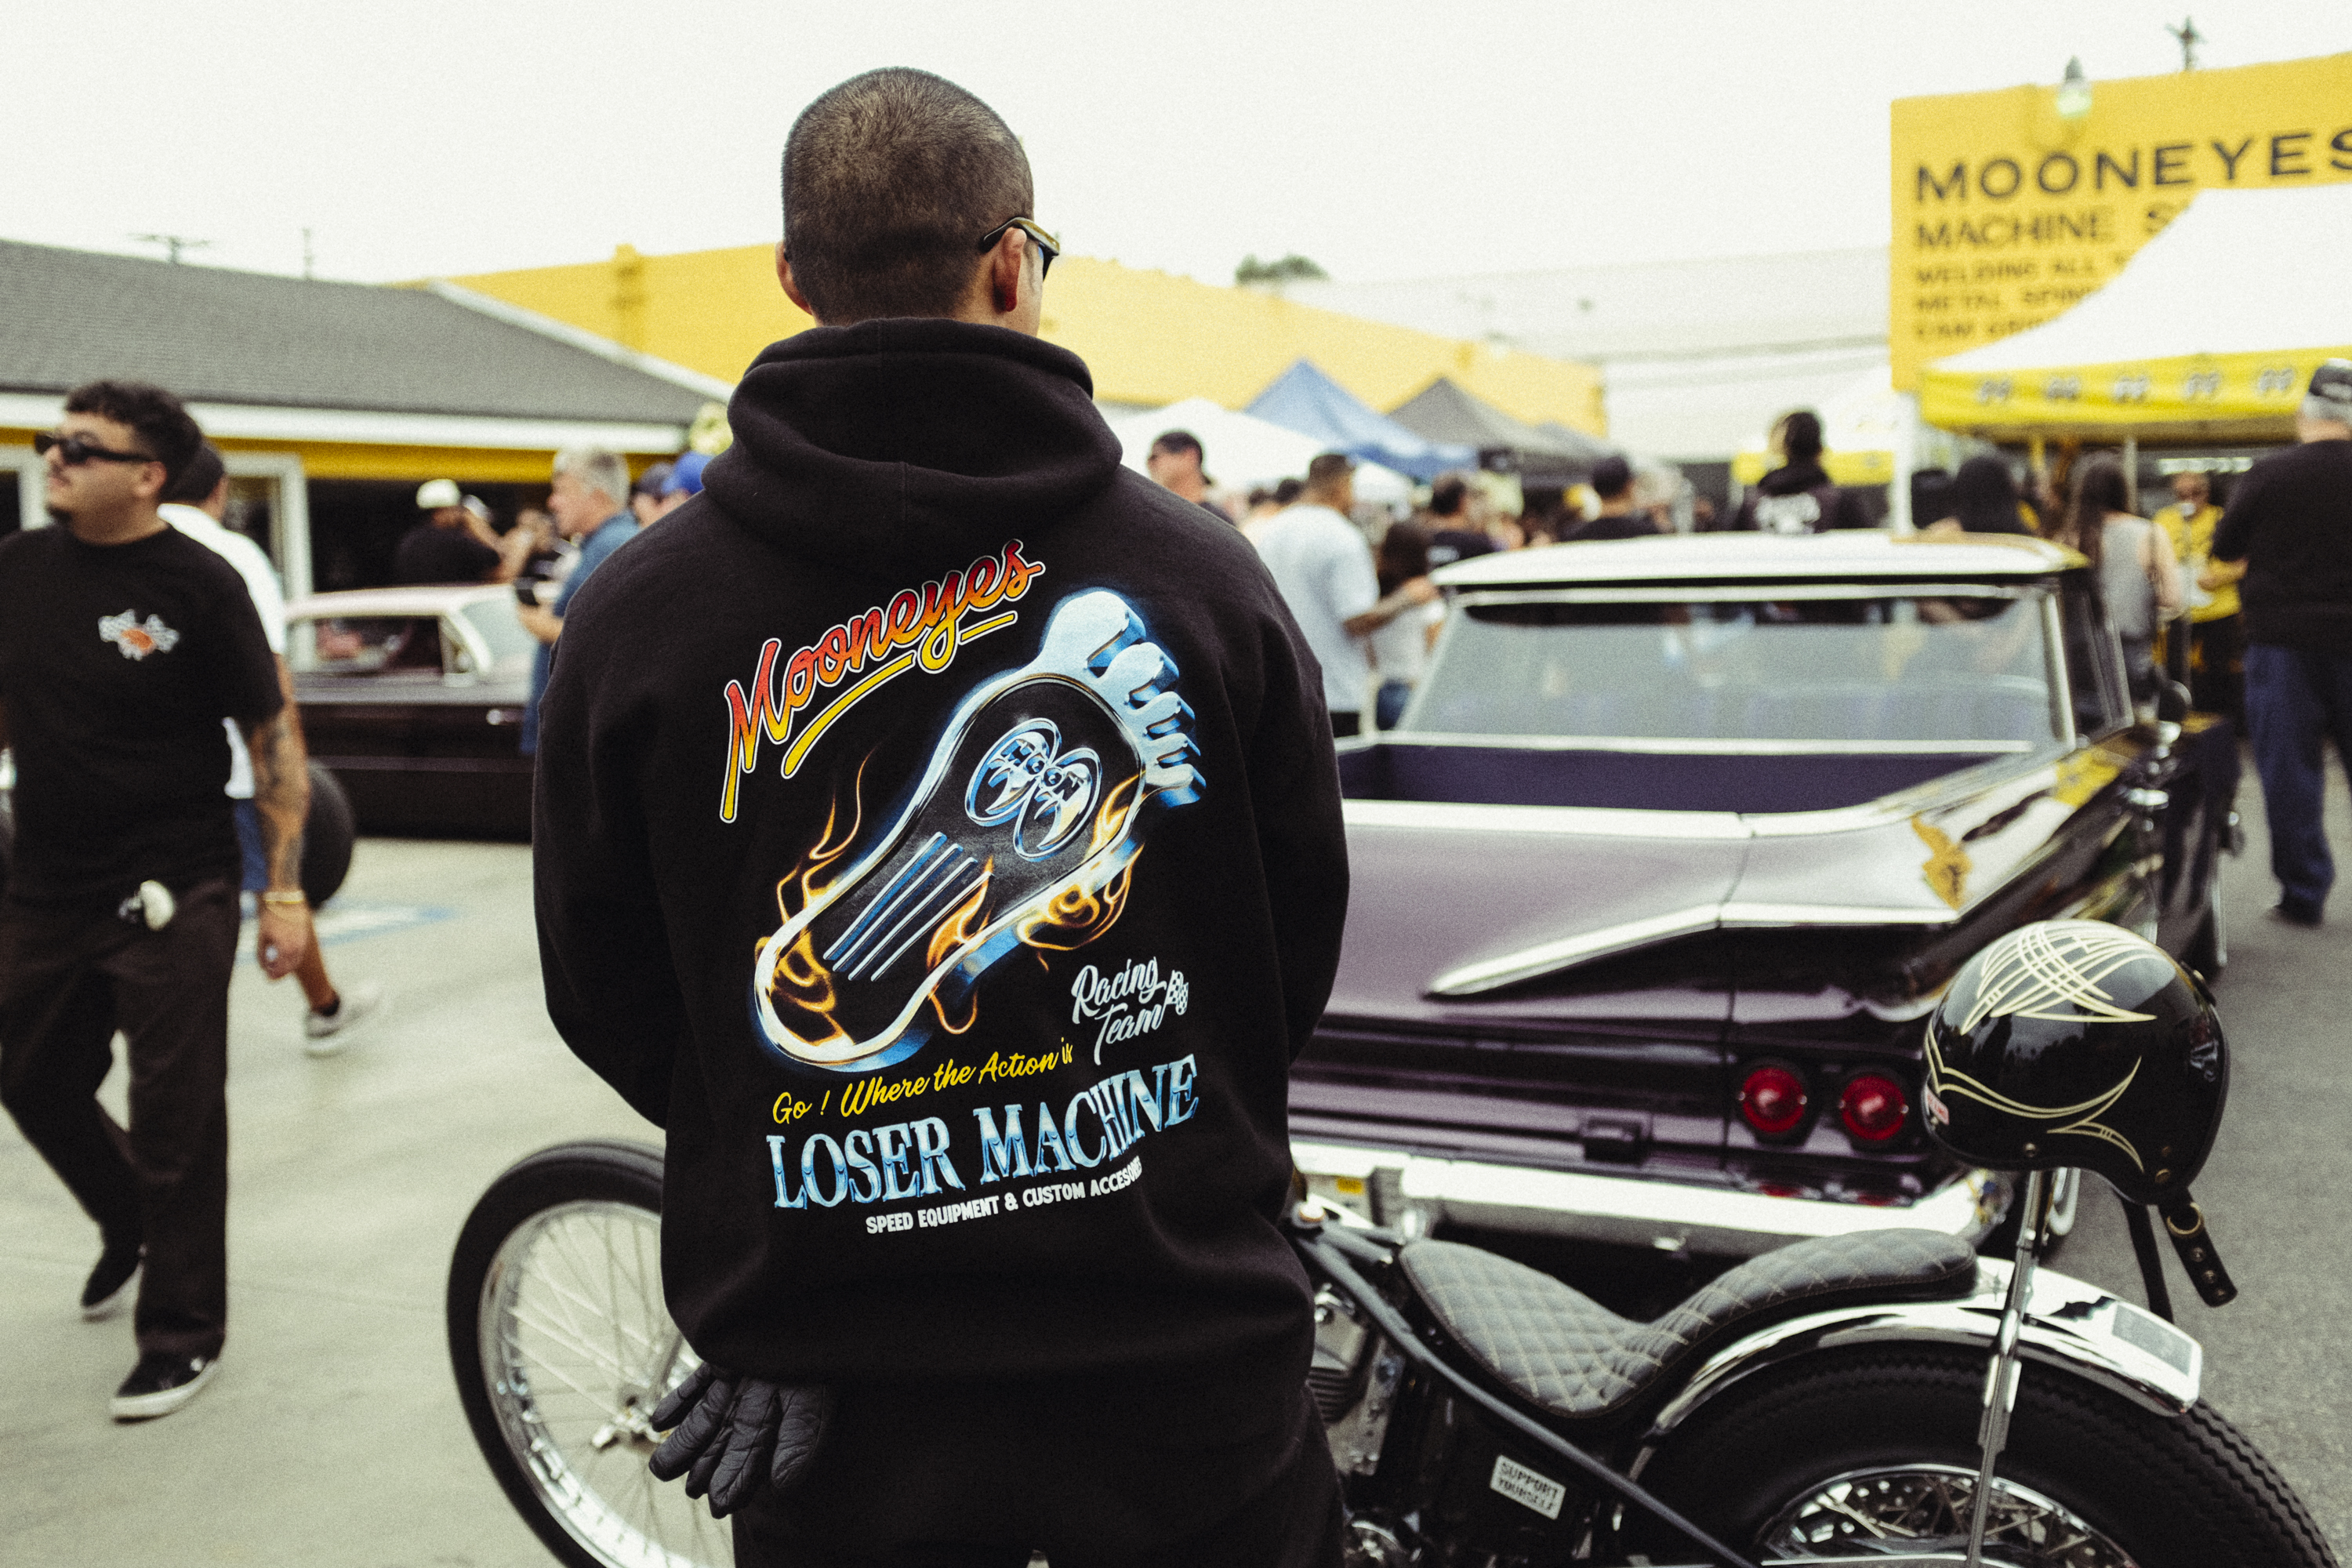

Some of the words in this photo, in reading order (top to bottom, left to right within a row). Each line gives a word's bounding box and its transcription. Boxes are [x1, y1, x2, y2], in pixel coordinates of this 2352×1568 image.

[1915, 205, 2114, 250] MACHINE
[720, 539, 1046, 823] Mooneyes
[1071, 956, 1167, 1025] Racing
[1094, 1002, 1167, 1065] Team
[772, 1091, 813, 1124] Go
[840, 1076, 931, 1117] Where
[933, 1058, 977, 1091] the
[978, 1051, 1059, 1084] Action
[1061, 1036, 1073, 1065] is
[765, 1116, 967, 1210] LOSER
[972, 1053, 1200, 1185] MACHINE
[865, 1211, 914, 1235] SPEED
[916, 1195, 1000, 1229] EQUIPMENT
[1004, 1192, 1019, 1212] &
[1022, 1181, 1087, 1208] CUSTOM
[1500, 1461, 1559, 1499] SUPPORT
